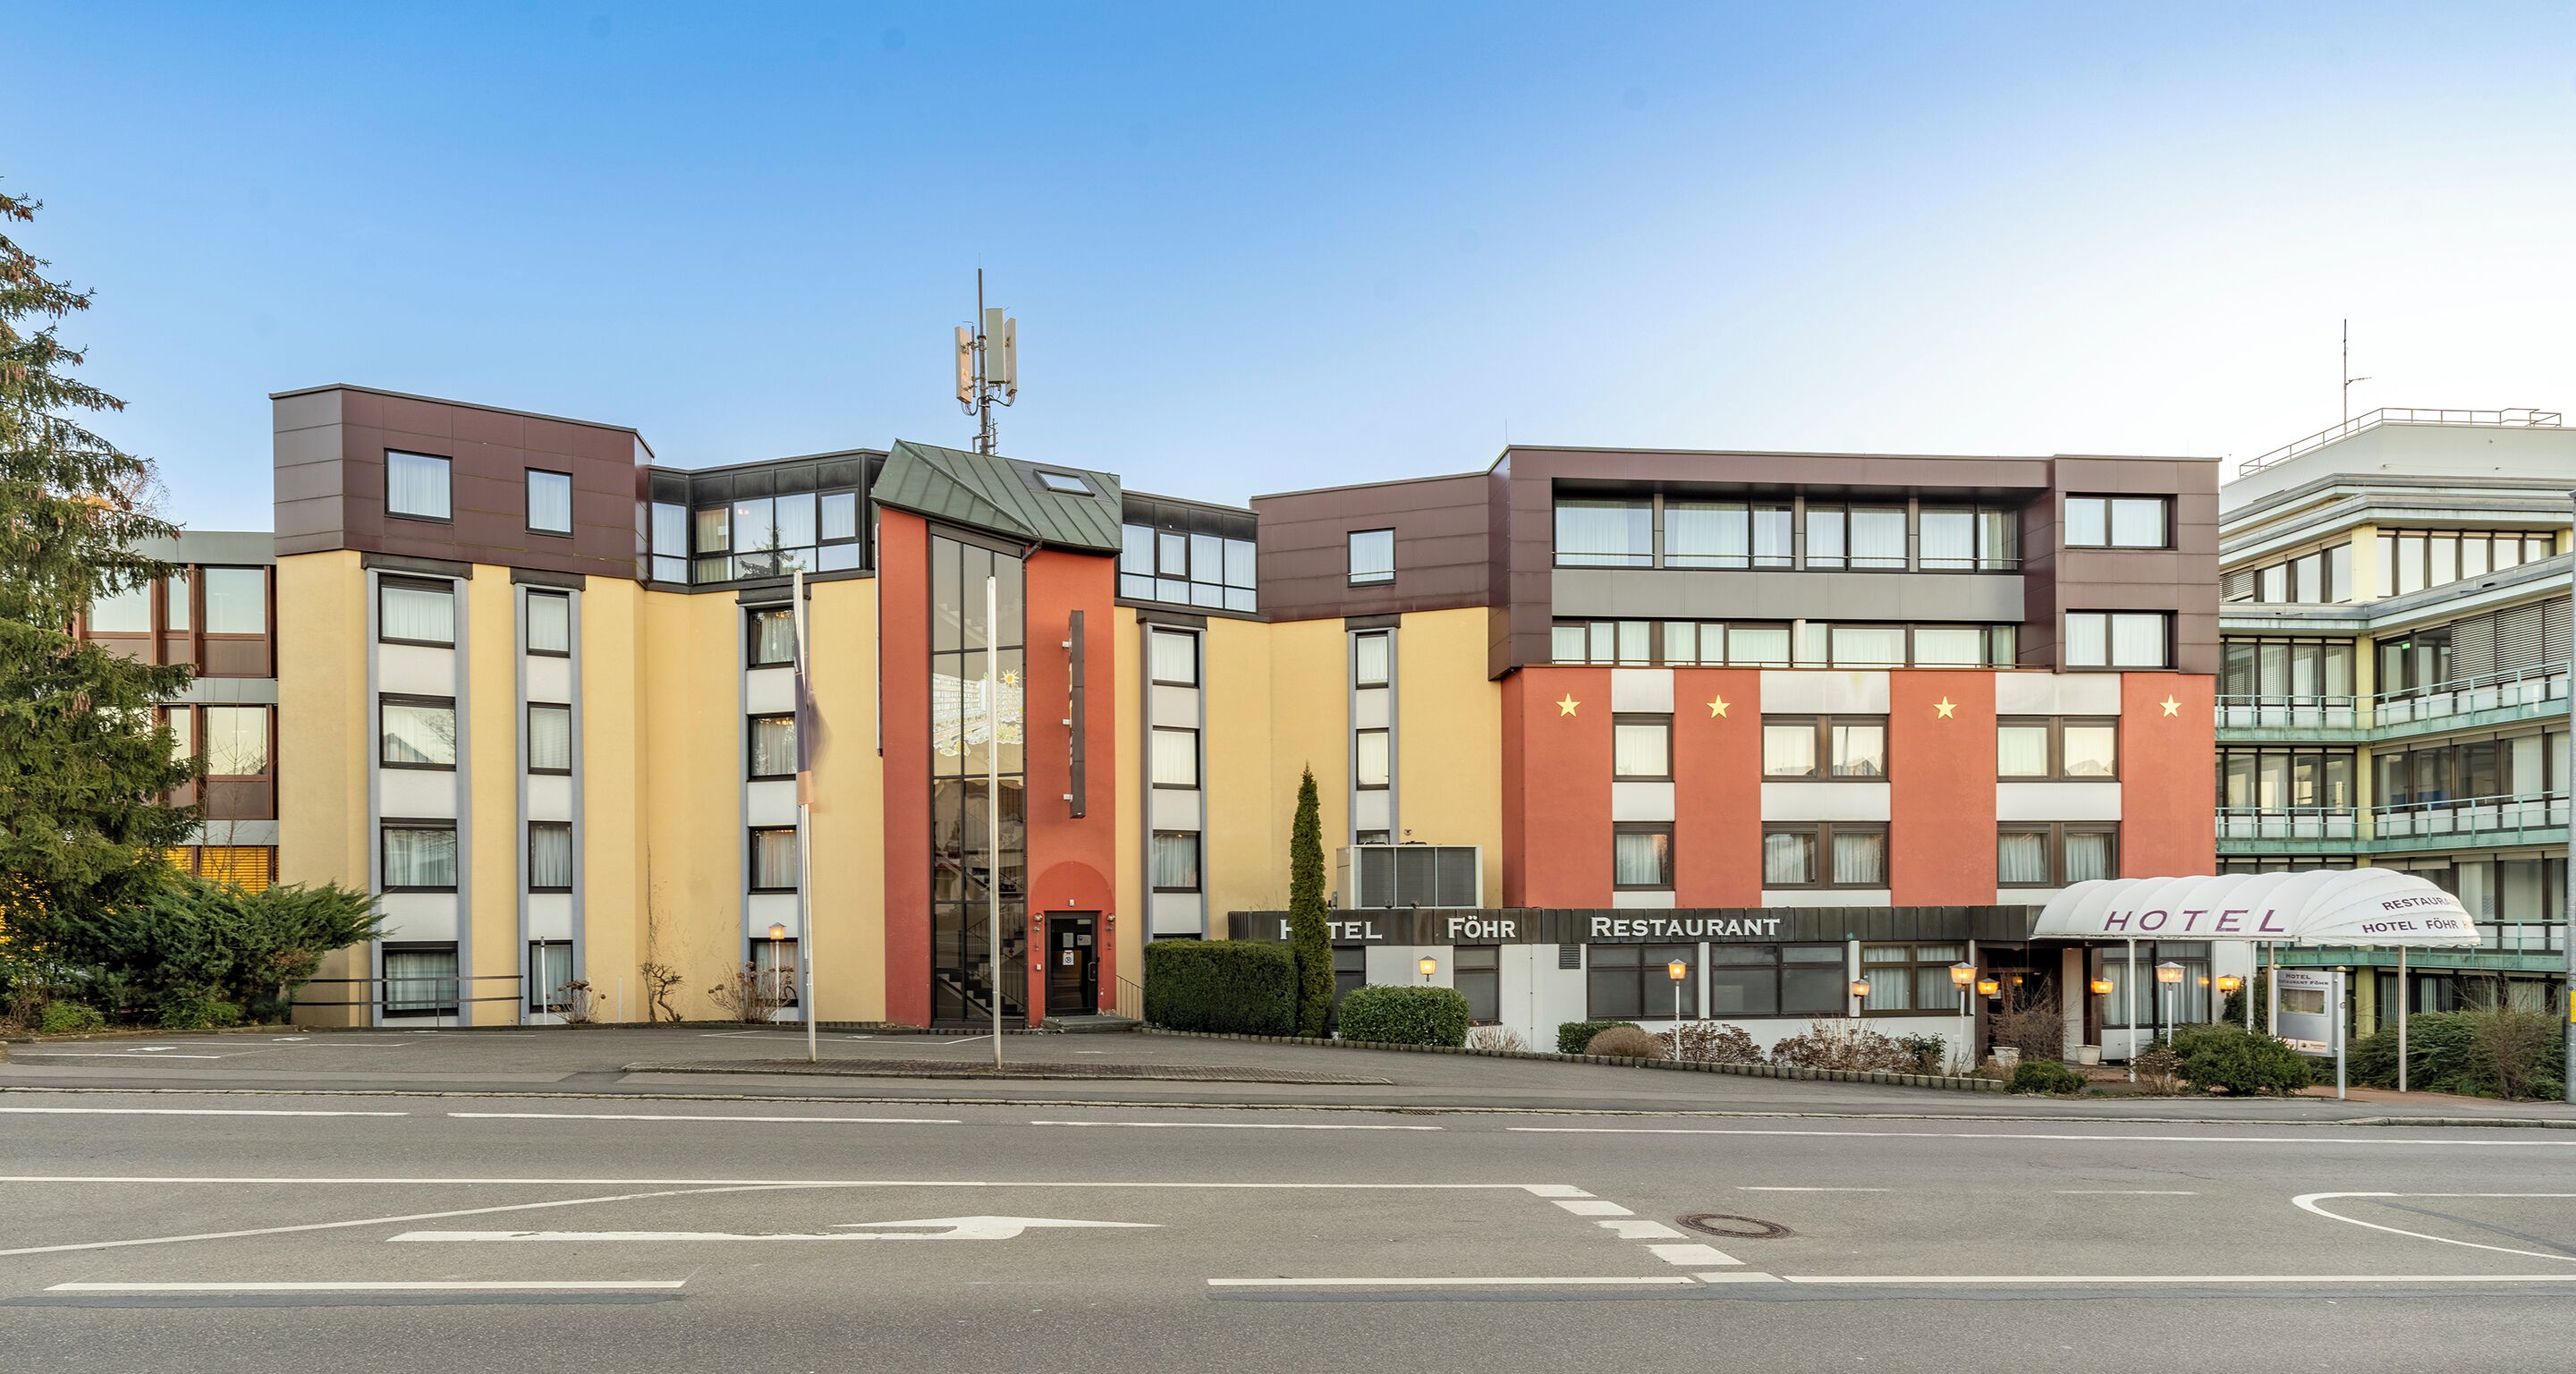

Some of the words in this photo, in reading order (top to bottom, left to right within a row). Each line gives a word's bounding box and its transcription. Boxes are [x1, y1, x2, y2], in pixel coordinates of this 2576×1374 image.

[2382, 897, 2460, 910] RESTAURA
[1280, 919, 1383, 939] HTEL
[1447, 915, 1516, 938] FÖHR
[1590, 917, 1780, 937] RESTAURANT
[2103, 909, 2285, 932] HOTEL
[2362, 920, 2418, 933] HOTEL
[2426, 917, 2459, 929] FÖHR
